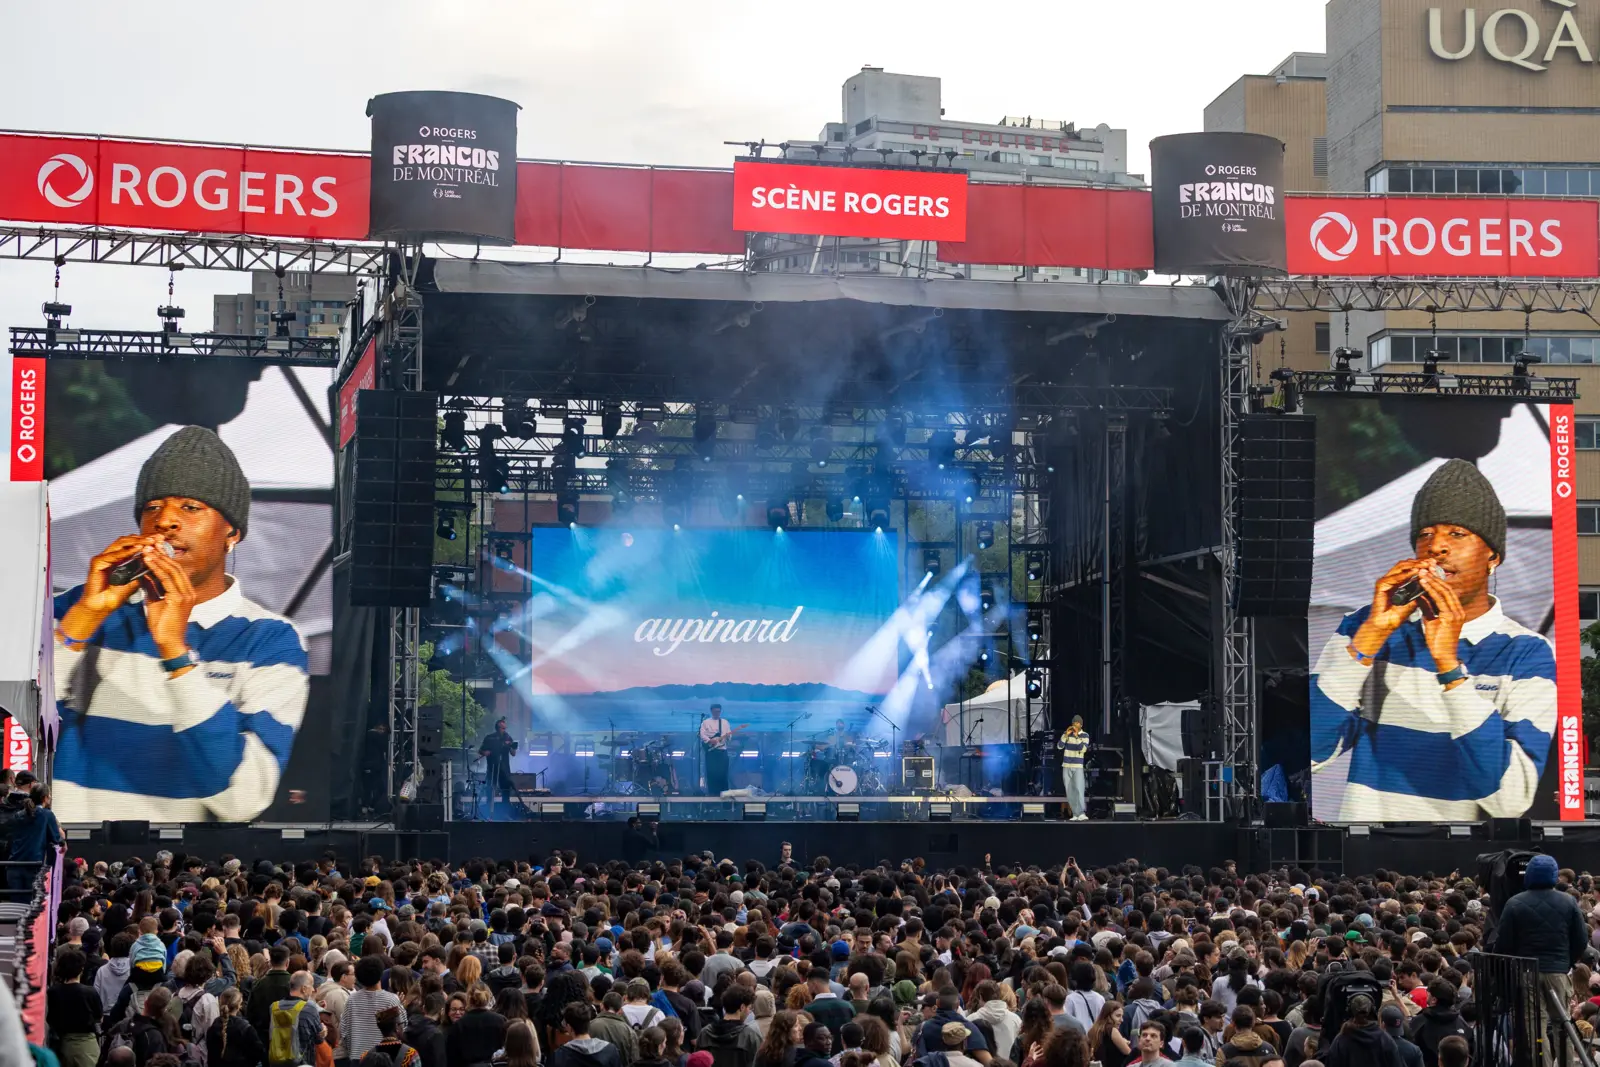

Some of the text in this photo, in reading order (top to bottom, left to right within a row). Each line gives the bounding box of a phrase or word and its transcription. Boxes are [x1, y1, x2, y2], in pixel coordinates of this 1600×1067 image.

[433, 127, 477, 140] ROGERS
[913, 124, 940, 141] LE
[393, 144, 499, 170] FRANCOS
[1218, 165, 1257, 176] ROGERS
[111, 164, 338, 218] ROGERS
[393, 166, 499, 187] DE MONTRÉAL
[751, 183, 950, 218] SCÈNE ROGERS
[1180, 182, 1274, 204] FRANCOS
[1181, 202, 1276, 220] DE MONTRÉAL
[1372, 217, 1563, 258] ROGERS
[20, 369, 36, 440] ROGERS
[1556, 415, 1569, 478] ROGERS
[634, 605, 804, 657] aypinard
[1562, 716, 1580, 808] FRANCOS
